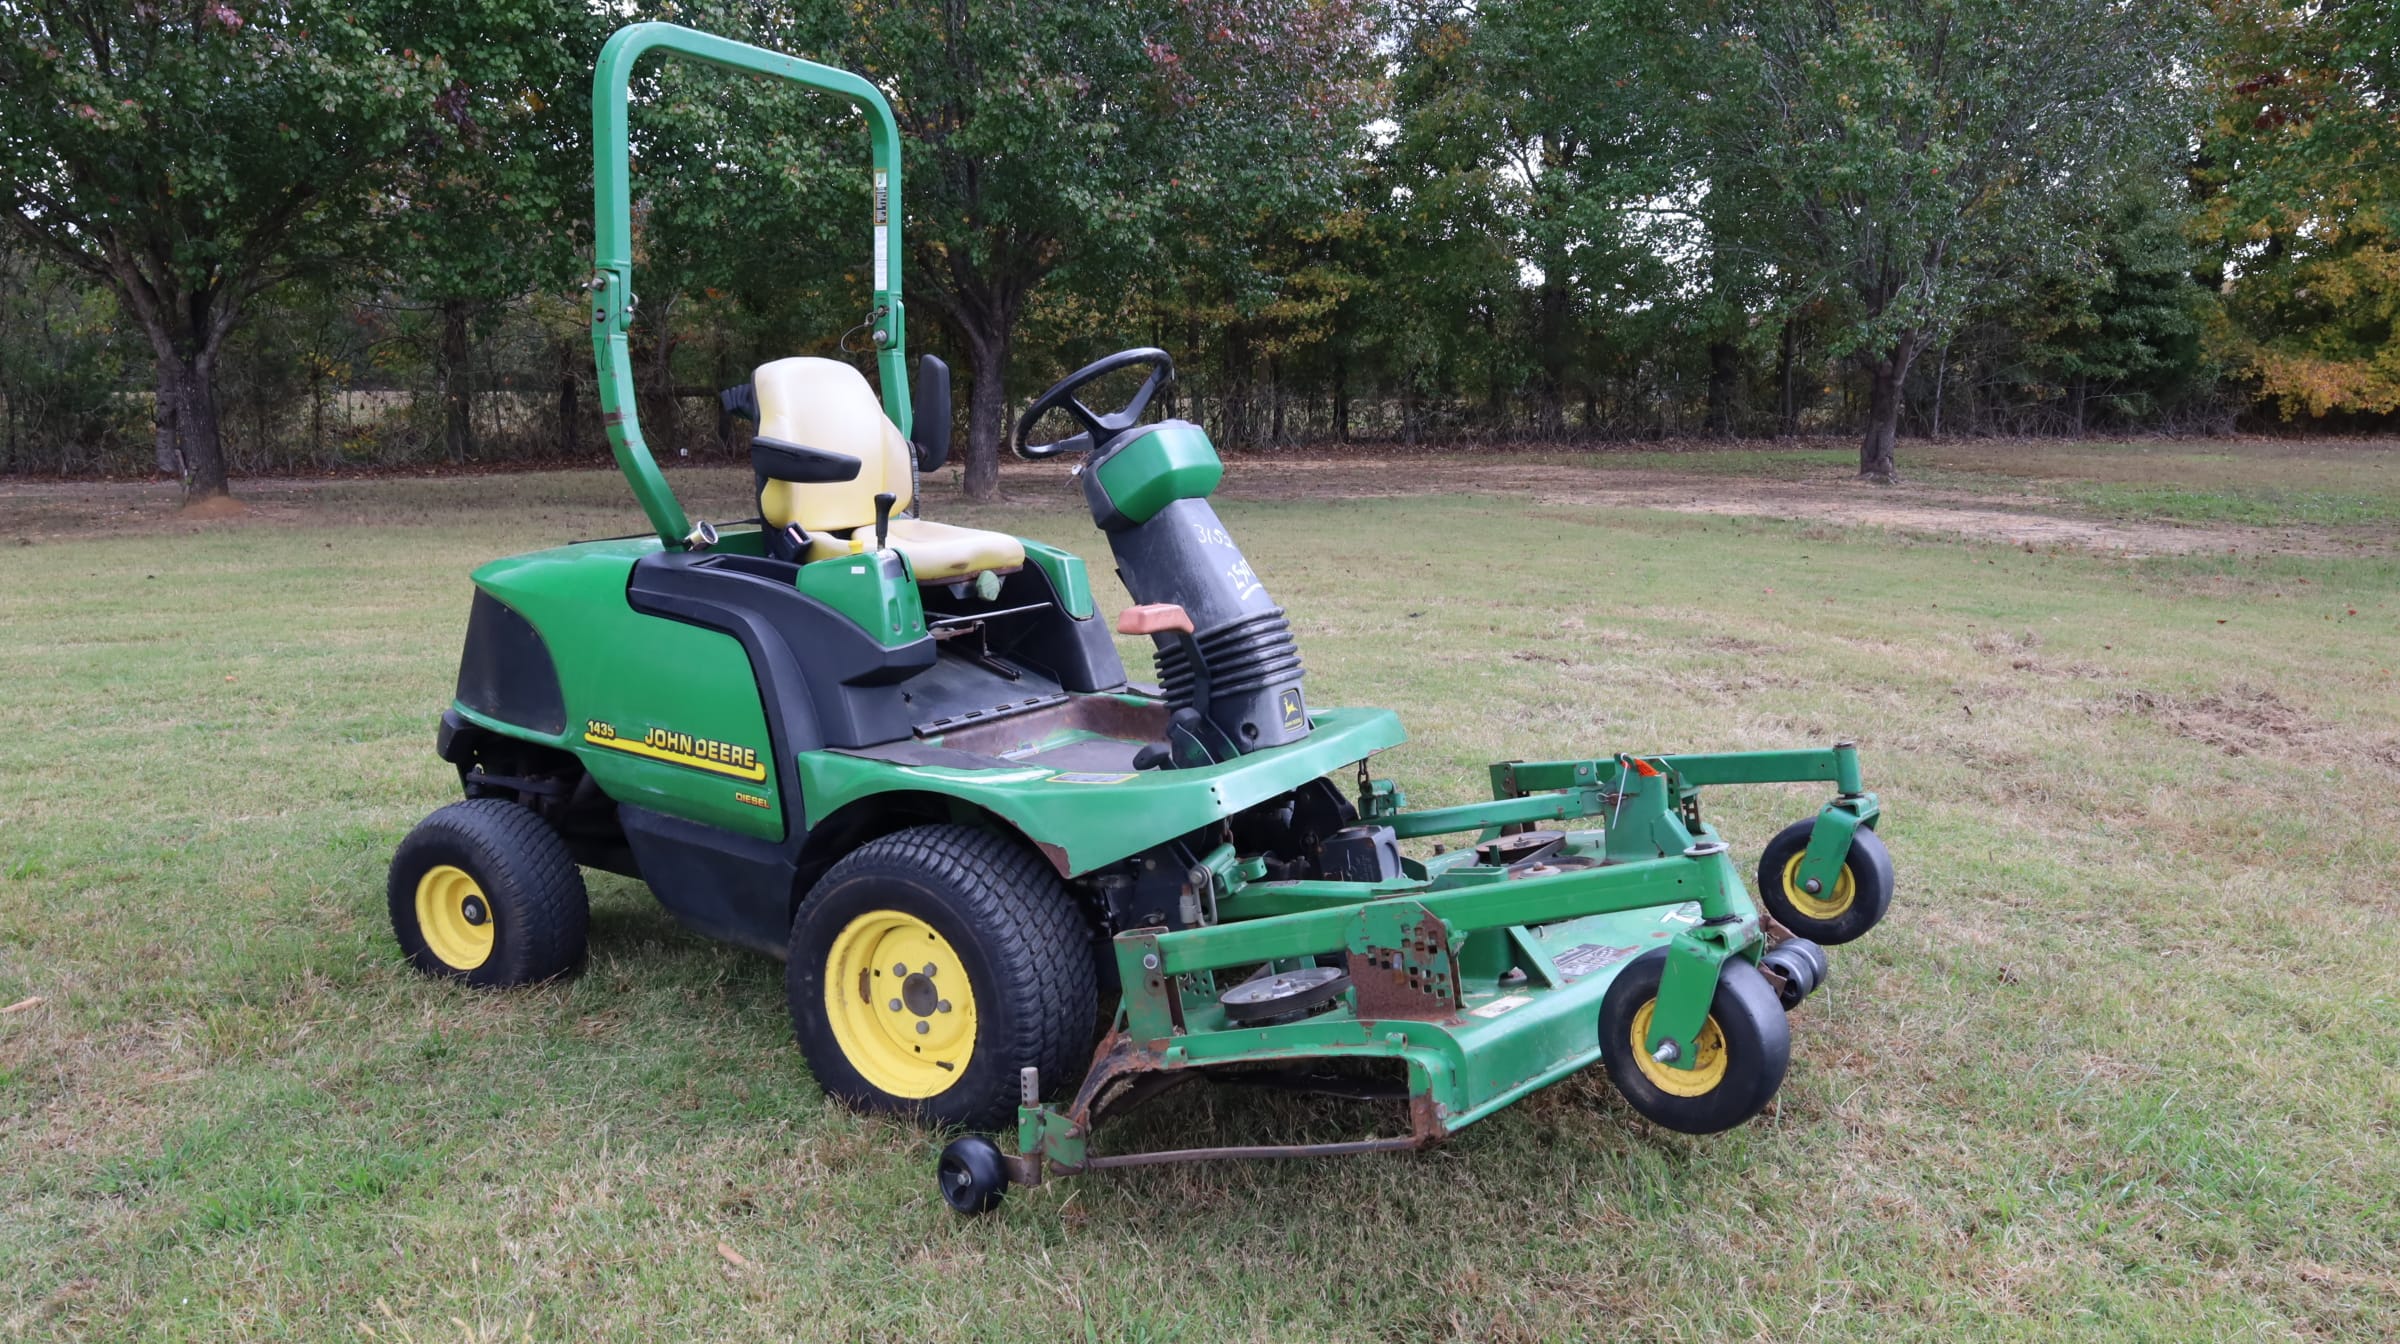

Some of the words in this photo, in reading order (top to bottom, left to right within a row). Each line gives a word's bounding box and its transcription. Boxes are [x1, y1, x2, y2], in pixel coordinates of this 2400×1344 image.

[587, 720, 616, 738] 1435
[644, 727, 692, 754] JOHN
[695, 739, 755, 768] DEERE
[735, 792, 771, 809] DIESEL
